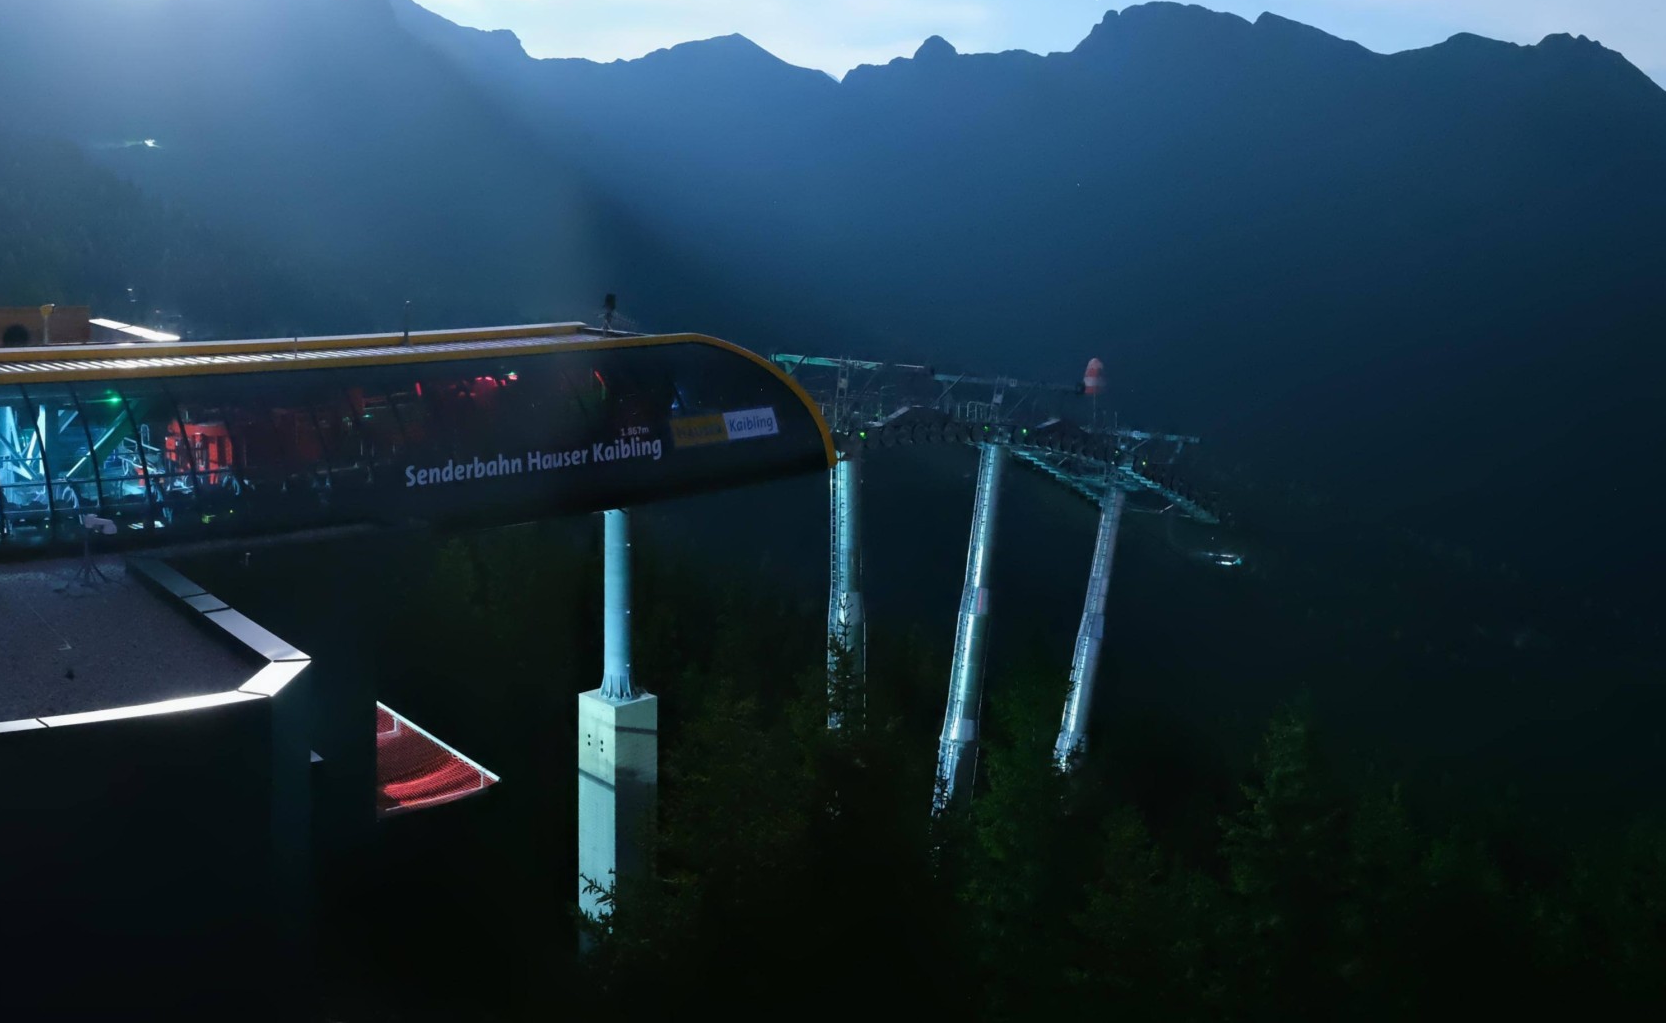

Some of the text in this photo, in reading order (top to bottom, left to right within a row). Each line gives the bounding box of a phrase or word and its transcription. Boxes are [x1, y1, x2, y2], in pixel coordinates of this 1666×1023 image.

[729, 417, 774, 432] Kaibling
[405, 436, 662, 488] Senderbahn Hauser Kaibling
